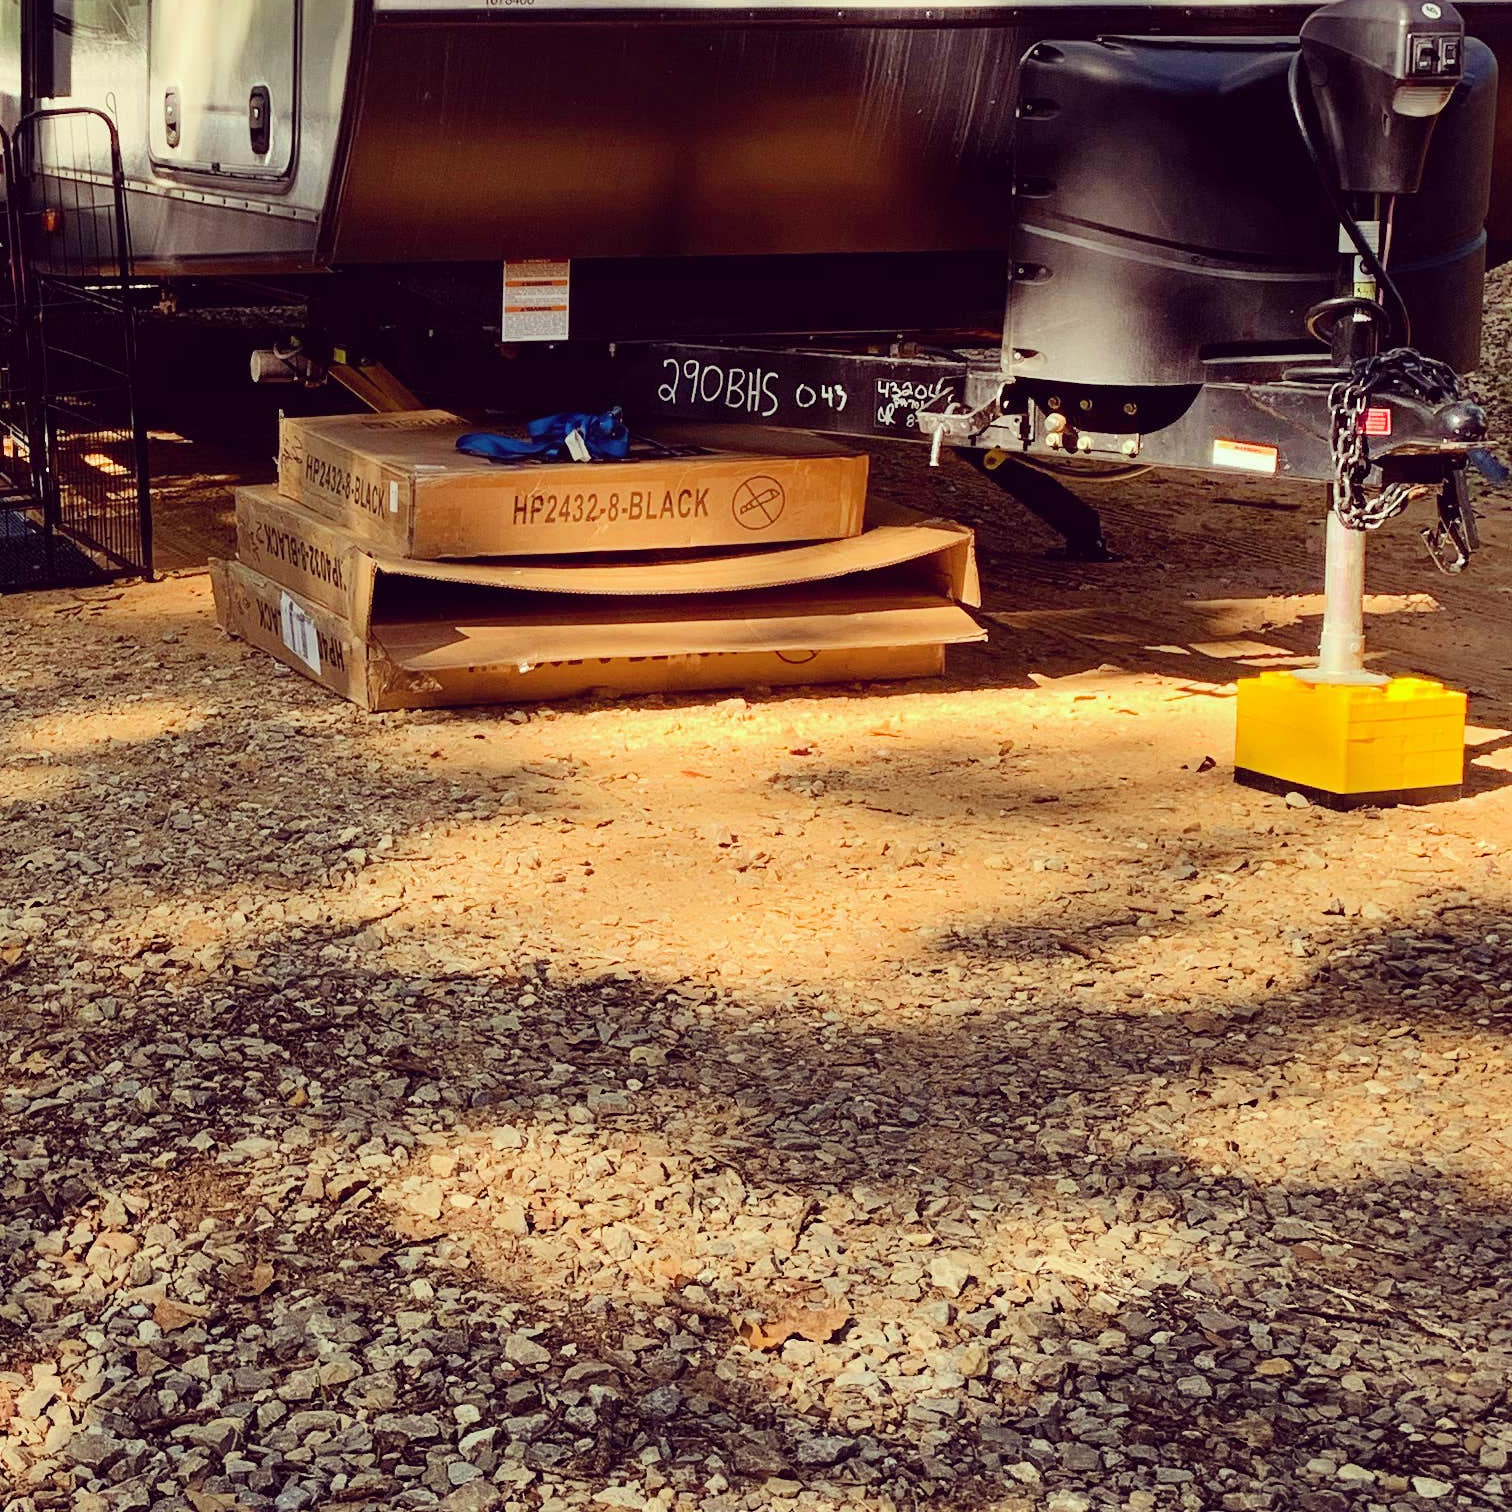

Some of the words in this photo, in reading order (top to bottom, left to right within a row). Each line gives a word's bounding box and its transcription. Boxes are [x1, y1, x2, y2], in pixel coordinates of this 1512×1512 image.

[658, 359, 779, 416] 290BHS
[796, 384, 847, 411] 043
[305, 454, 386, 519] HP2432-8-BLACK
[513, 488, 710, 525] HP2432-8-BLACK
